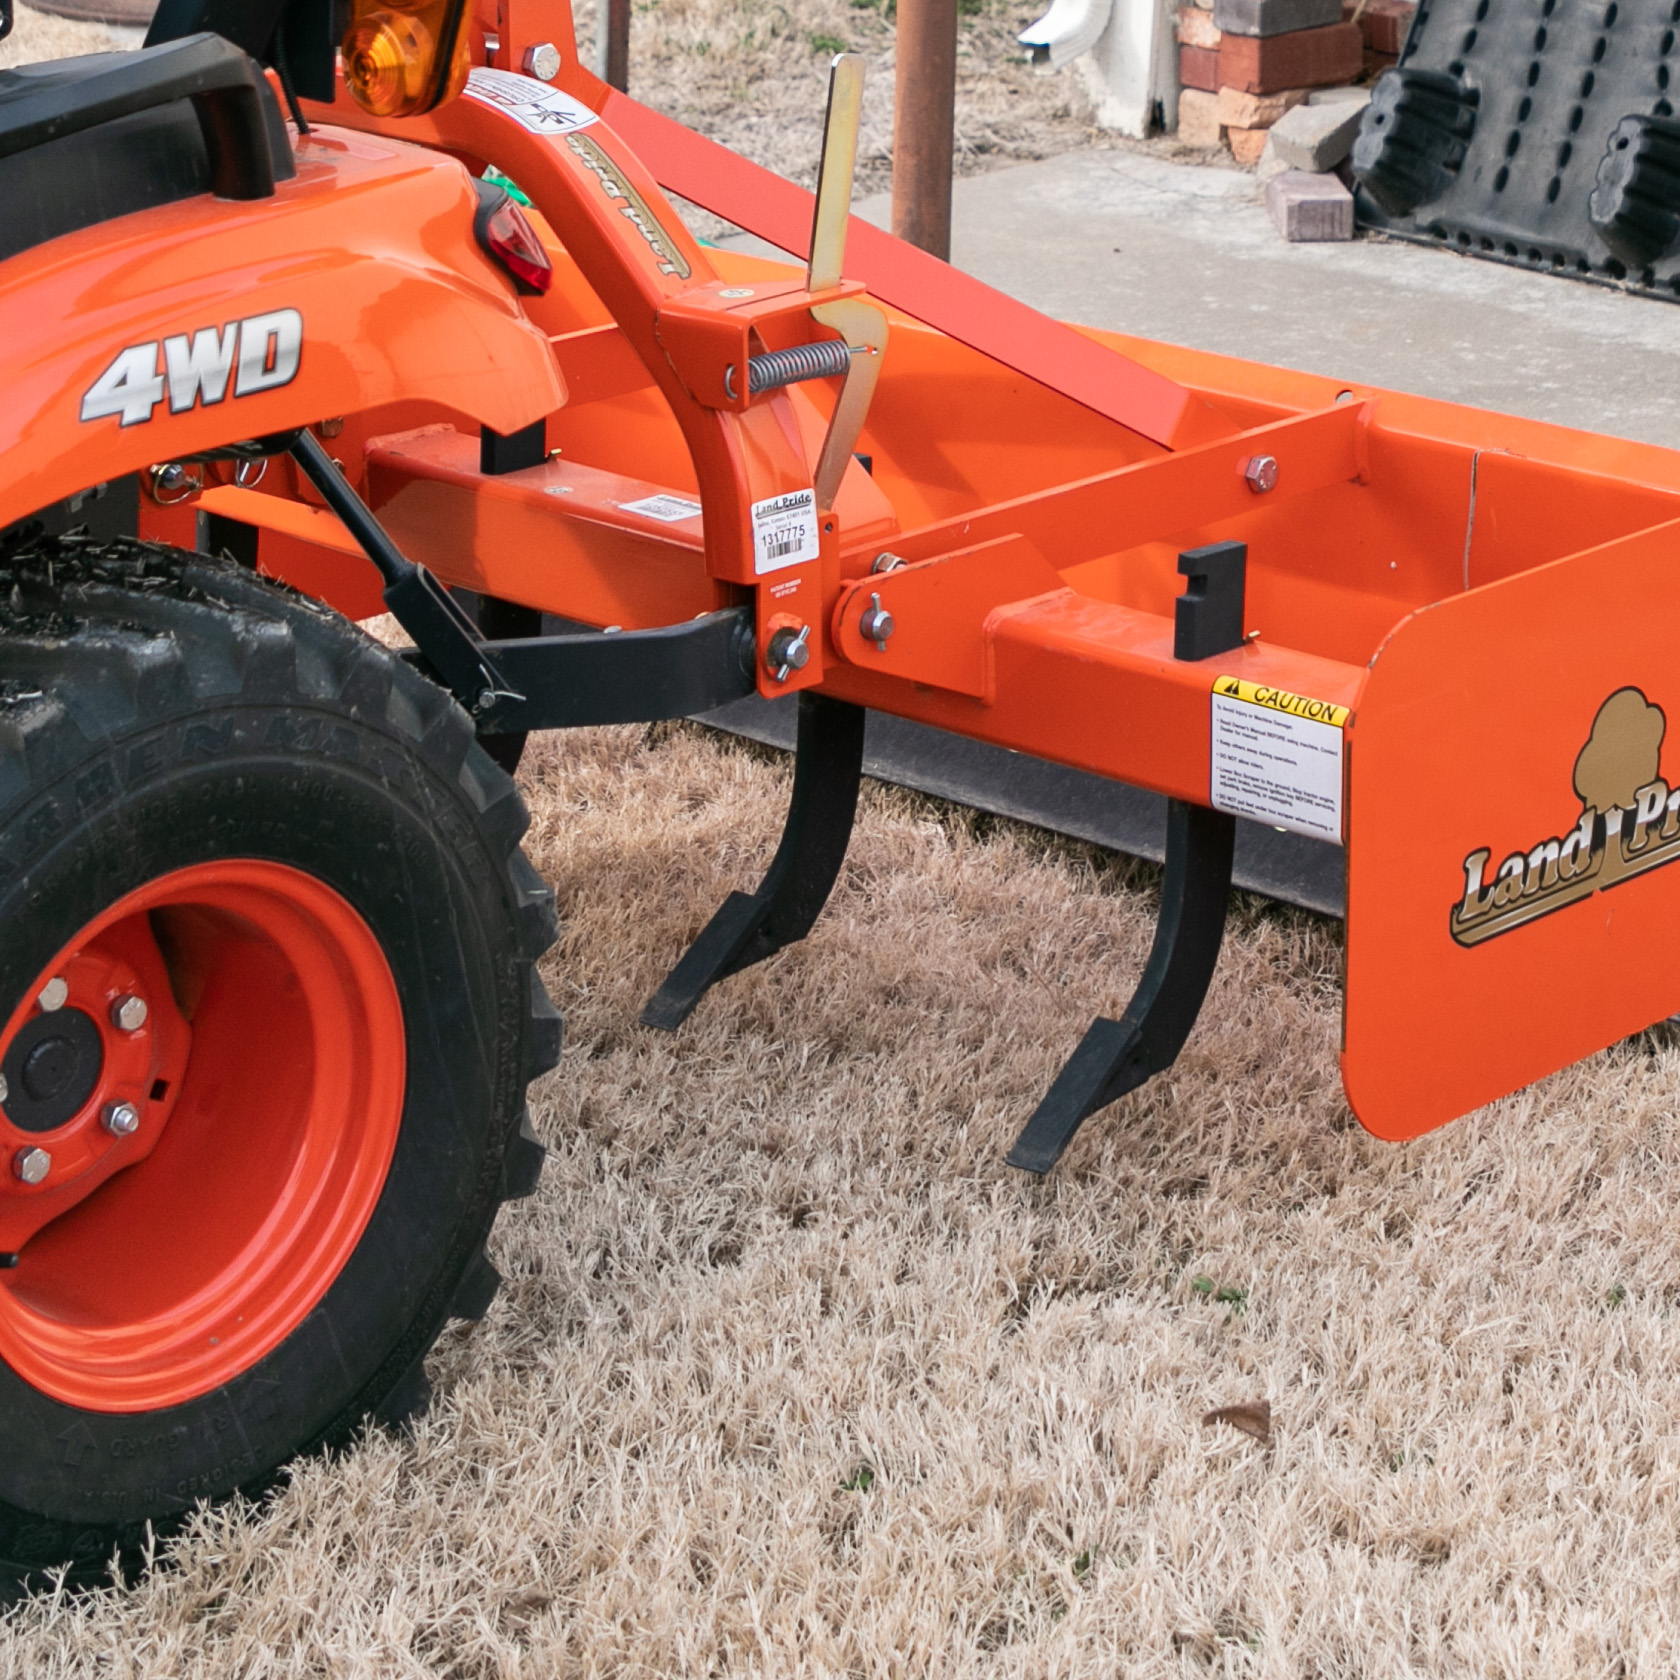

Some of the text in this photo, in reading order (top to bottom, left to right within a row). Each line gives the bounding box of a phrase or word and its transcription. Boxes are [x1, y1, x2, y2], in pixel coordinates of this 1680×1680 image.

[565, 134, 684, 278] Land Pride
[79, 307, 304, 428] 4WD
[755, 493, 812, 518] Land Pride
[762, 525, 806, 547] 1317775
[1254, 687, 1337, 722] CAUTION
[1457, 806, 1597, 922] Land
